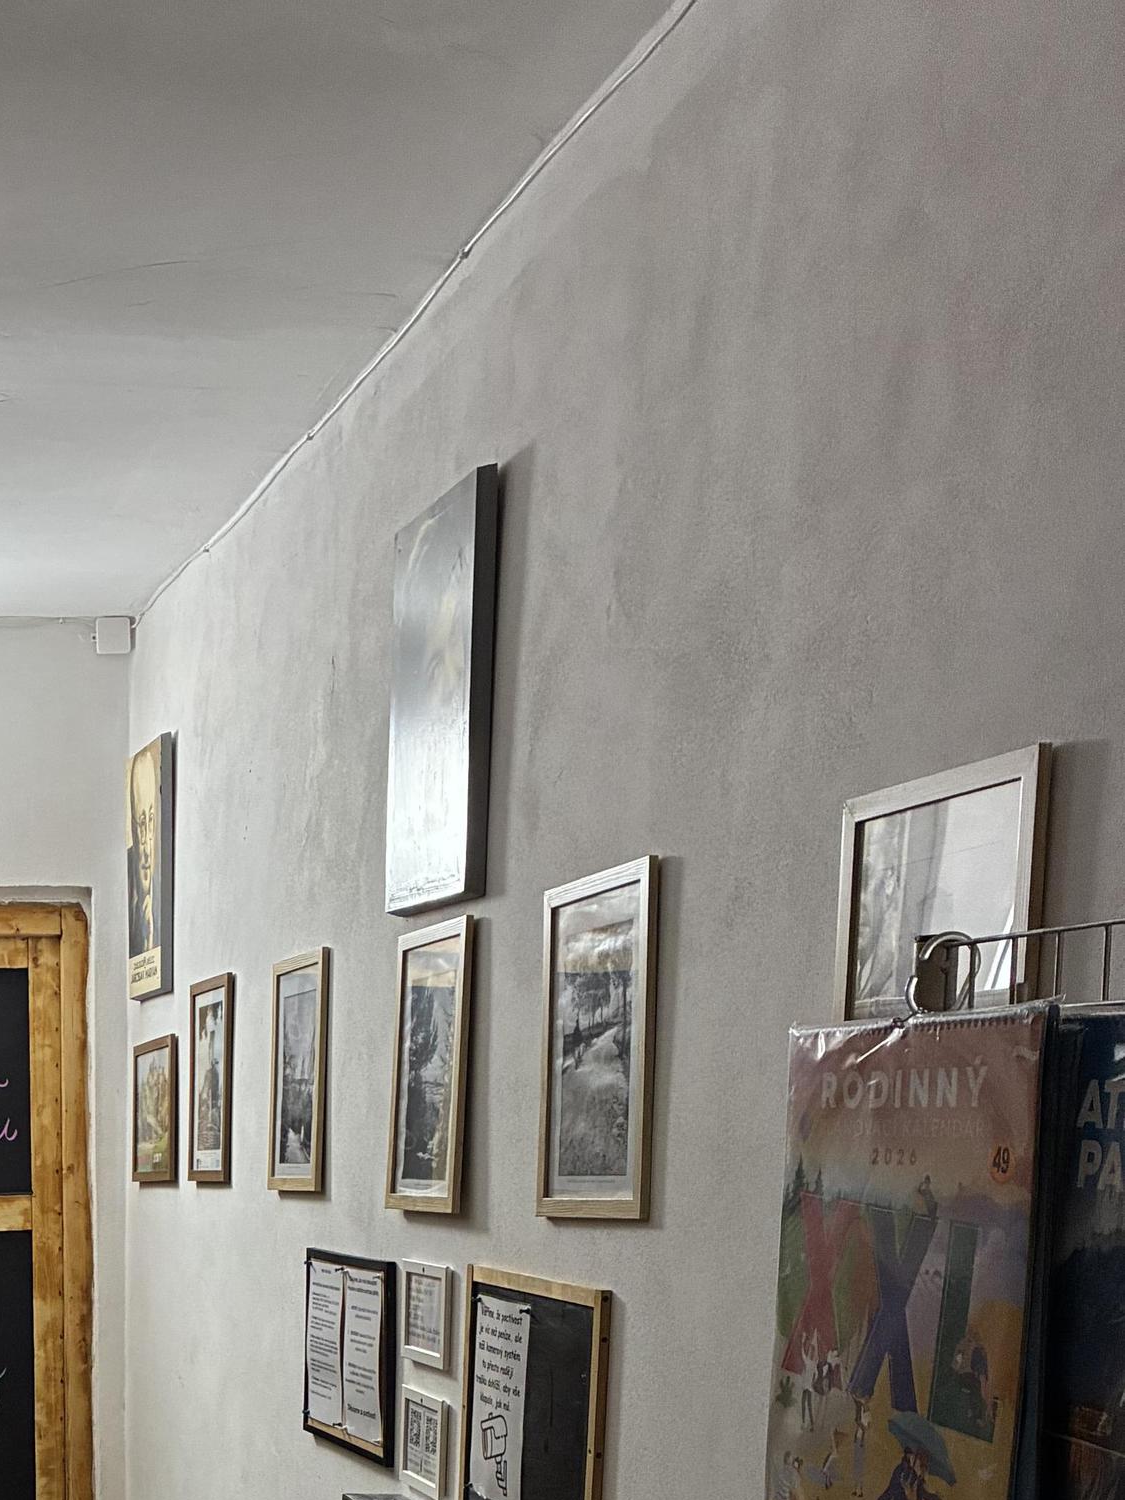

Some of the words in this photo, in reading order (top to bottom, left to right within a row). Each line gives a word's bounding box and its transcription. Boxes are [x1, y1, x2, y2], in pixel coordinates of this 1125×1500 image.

[821, 1055, 988, 1109] RODINNÝ
[871, 1146, 918, 1166] 2026
[992, 1146, 1010, 1174] 49
